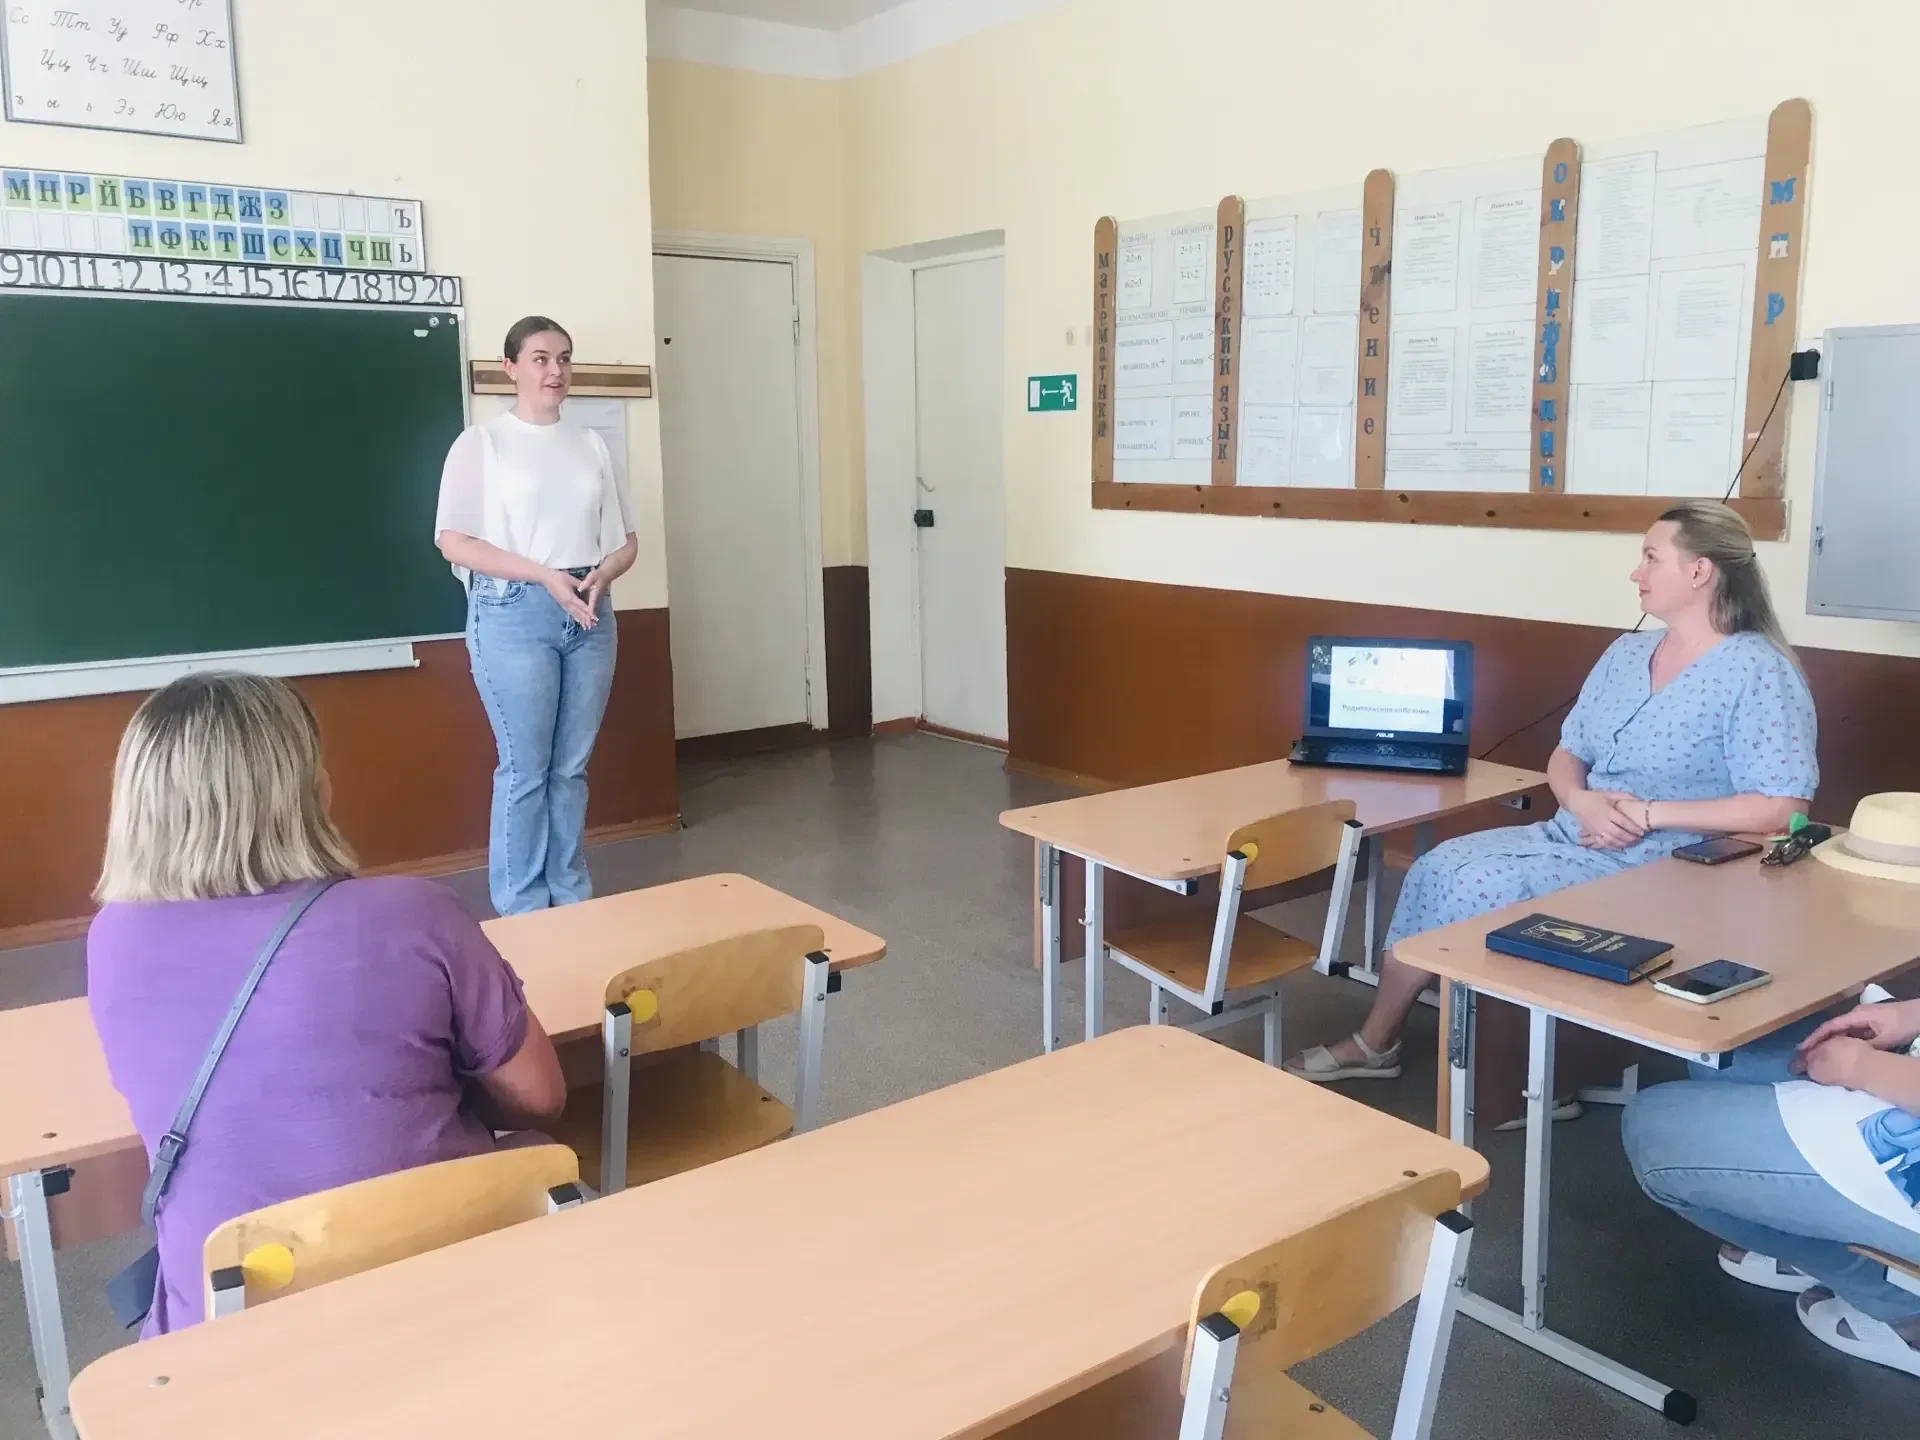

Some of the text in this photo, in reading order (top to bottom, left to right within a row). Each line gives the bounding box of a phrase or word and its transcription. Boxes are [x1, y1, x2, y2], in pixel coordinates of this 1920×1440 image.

[196, 29, 226, 48] Хх
[27, 255, 65, 288] 10
[69, 257, 104, 290] 11
[112, 259, 151, 292] 12
[157, 261, 192, 293] 13
[239, 266, 273, 298] 15
[279, 269, 310, 299] 16
[316, 271, 347, 301] 17
[350, 273, 383, 303] 18
[386, 275, 417, 305] 19
[422, 276, 457, 306] 20
